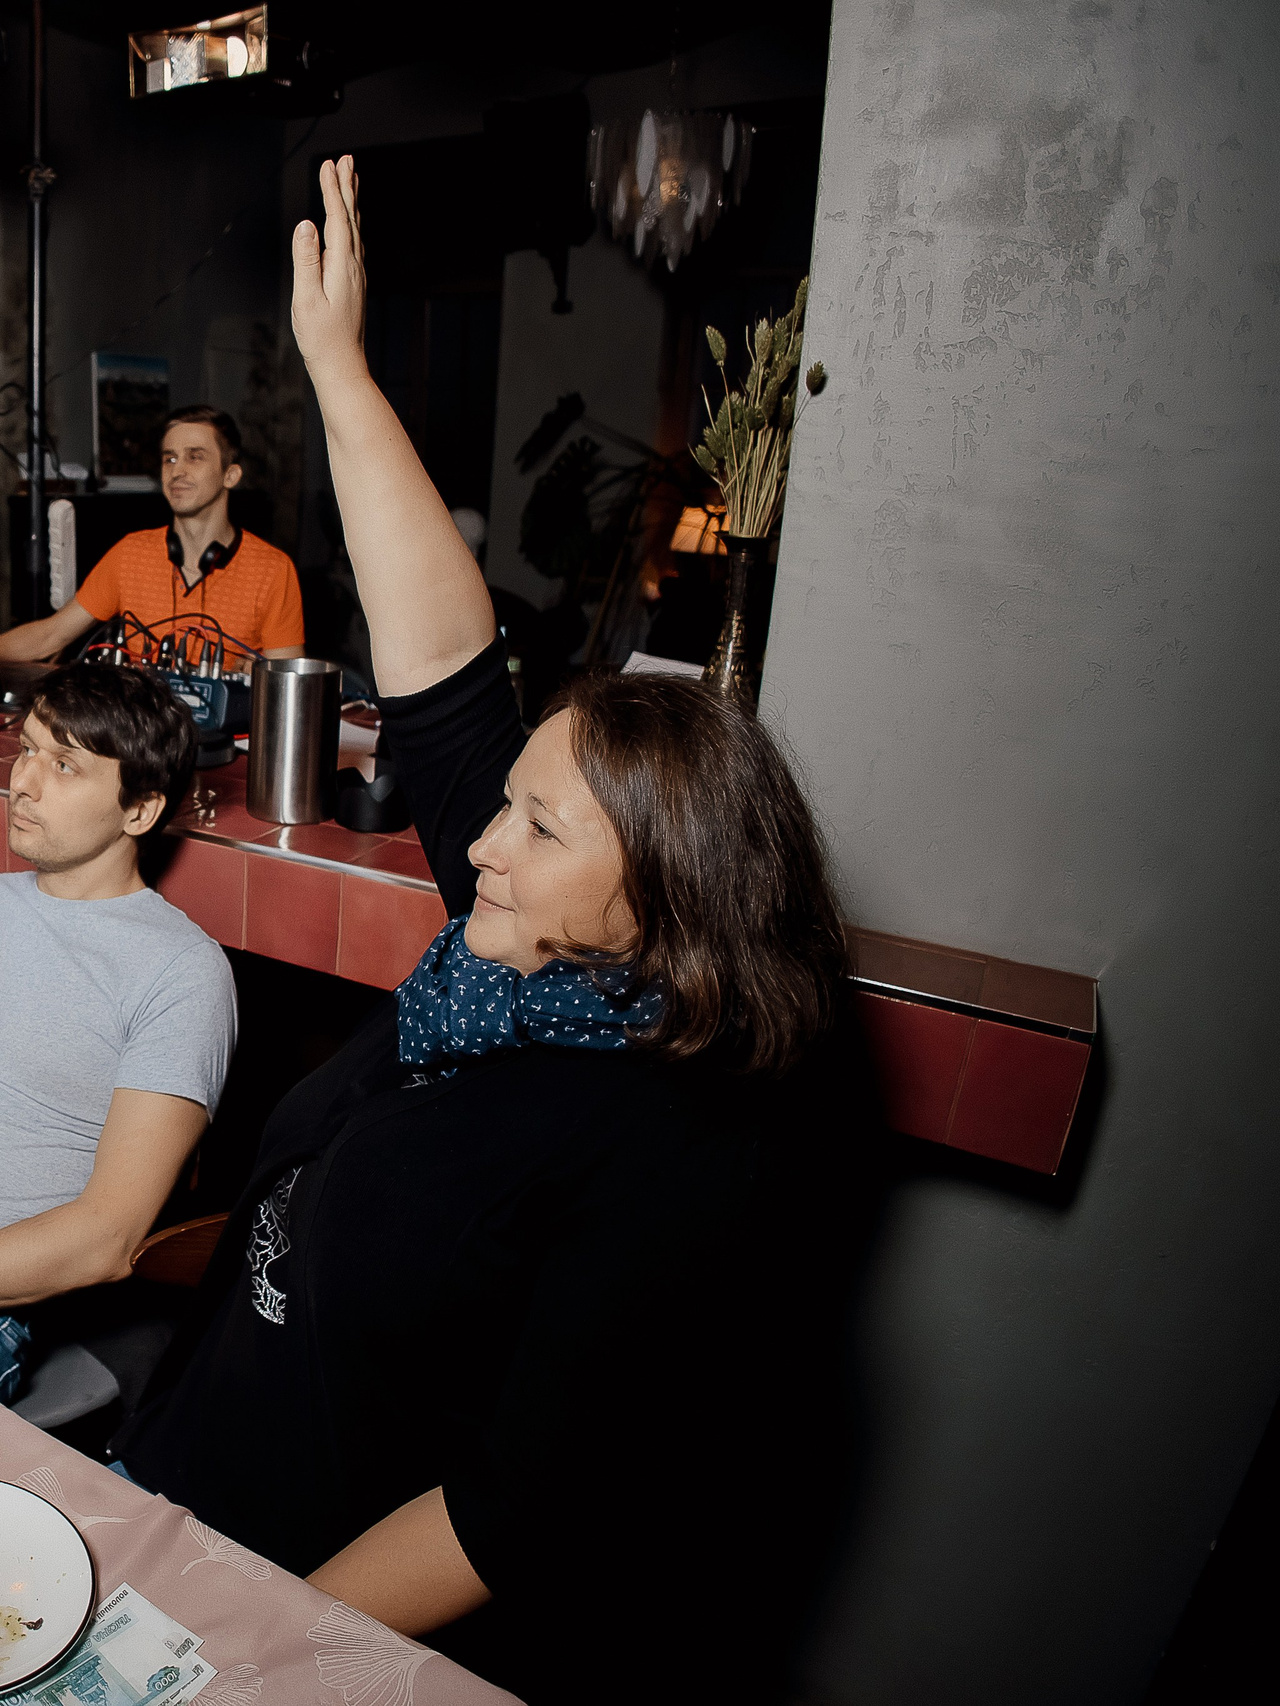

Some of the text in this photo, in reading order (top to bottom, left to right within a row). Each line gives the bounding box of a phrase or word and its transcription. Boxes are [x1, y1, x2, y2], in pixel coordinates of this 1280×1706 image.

[96, 1589, 129, 1620] ПРИКОЛОВ
[92, 1613, 132, 1643] ТЫСЯЧА
[154, 1670, 178, 1692] 1000
